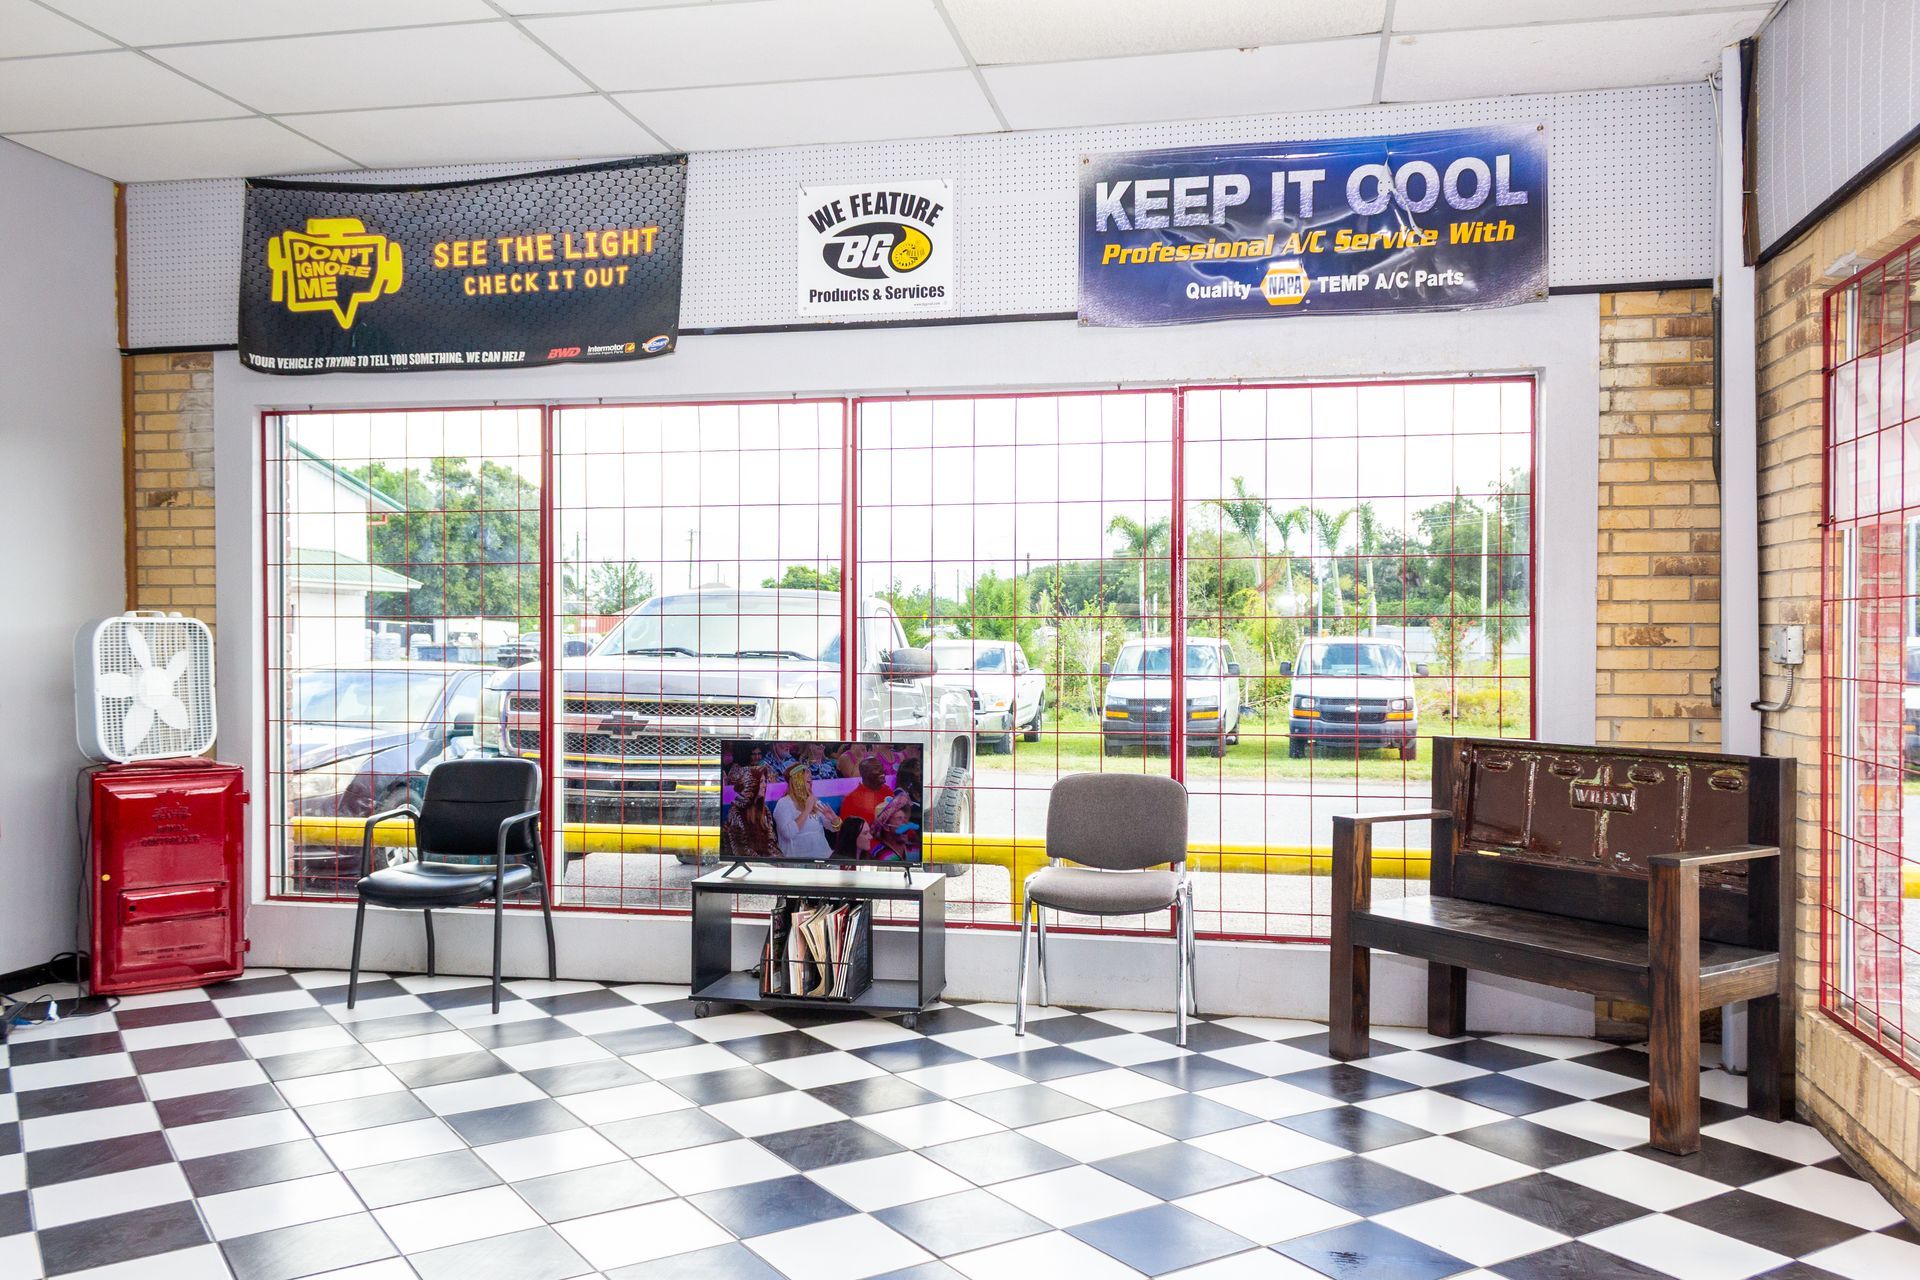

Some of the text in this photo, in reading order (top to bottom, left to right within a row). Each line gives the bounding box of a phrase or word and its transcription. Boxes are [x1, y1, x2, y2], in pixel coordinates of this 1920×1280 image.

[808, 191, 944, 234] WE FEATURE
[1096, 173, 1251, 232] KEEP
[1271, 169, 1326, 221] IT
[293, 242, 374, 266] DON'T
[434, 227, 658, 268] SEE THE LIGHT
[832, 233, 895, 270] BG
[1102, 219, 1516, 265] Professional A/C Service With
[296, 261, 372, 279] IGNORE
[464, 265, 629, 296] CHECK IT OUT
[298, 276, 338, 299] ME
[809, 284, 945, 303] Products & Services
[1186, 269, 1464, 300] Quality NAPA TEMP A/C Parts
[249, 353, 276, 369] YOUR
[277, 357, 313, 369] VEHICLE
[314, 357, 324, 369] IS
[324, 355, 357, 368] TRYING
[358, 355, 369, 367] TO
[370, 354, 389, 367] TELL
[390, 354, 408, 366] YOU
[409, 352, 464, 365] SOMETHING.
[466, 352, 481, 364] WE
[482, 351, 500, 363] CAN
[548, 347, 581, 359] BWD
[588, 344, 625, 353] Intermotor
